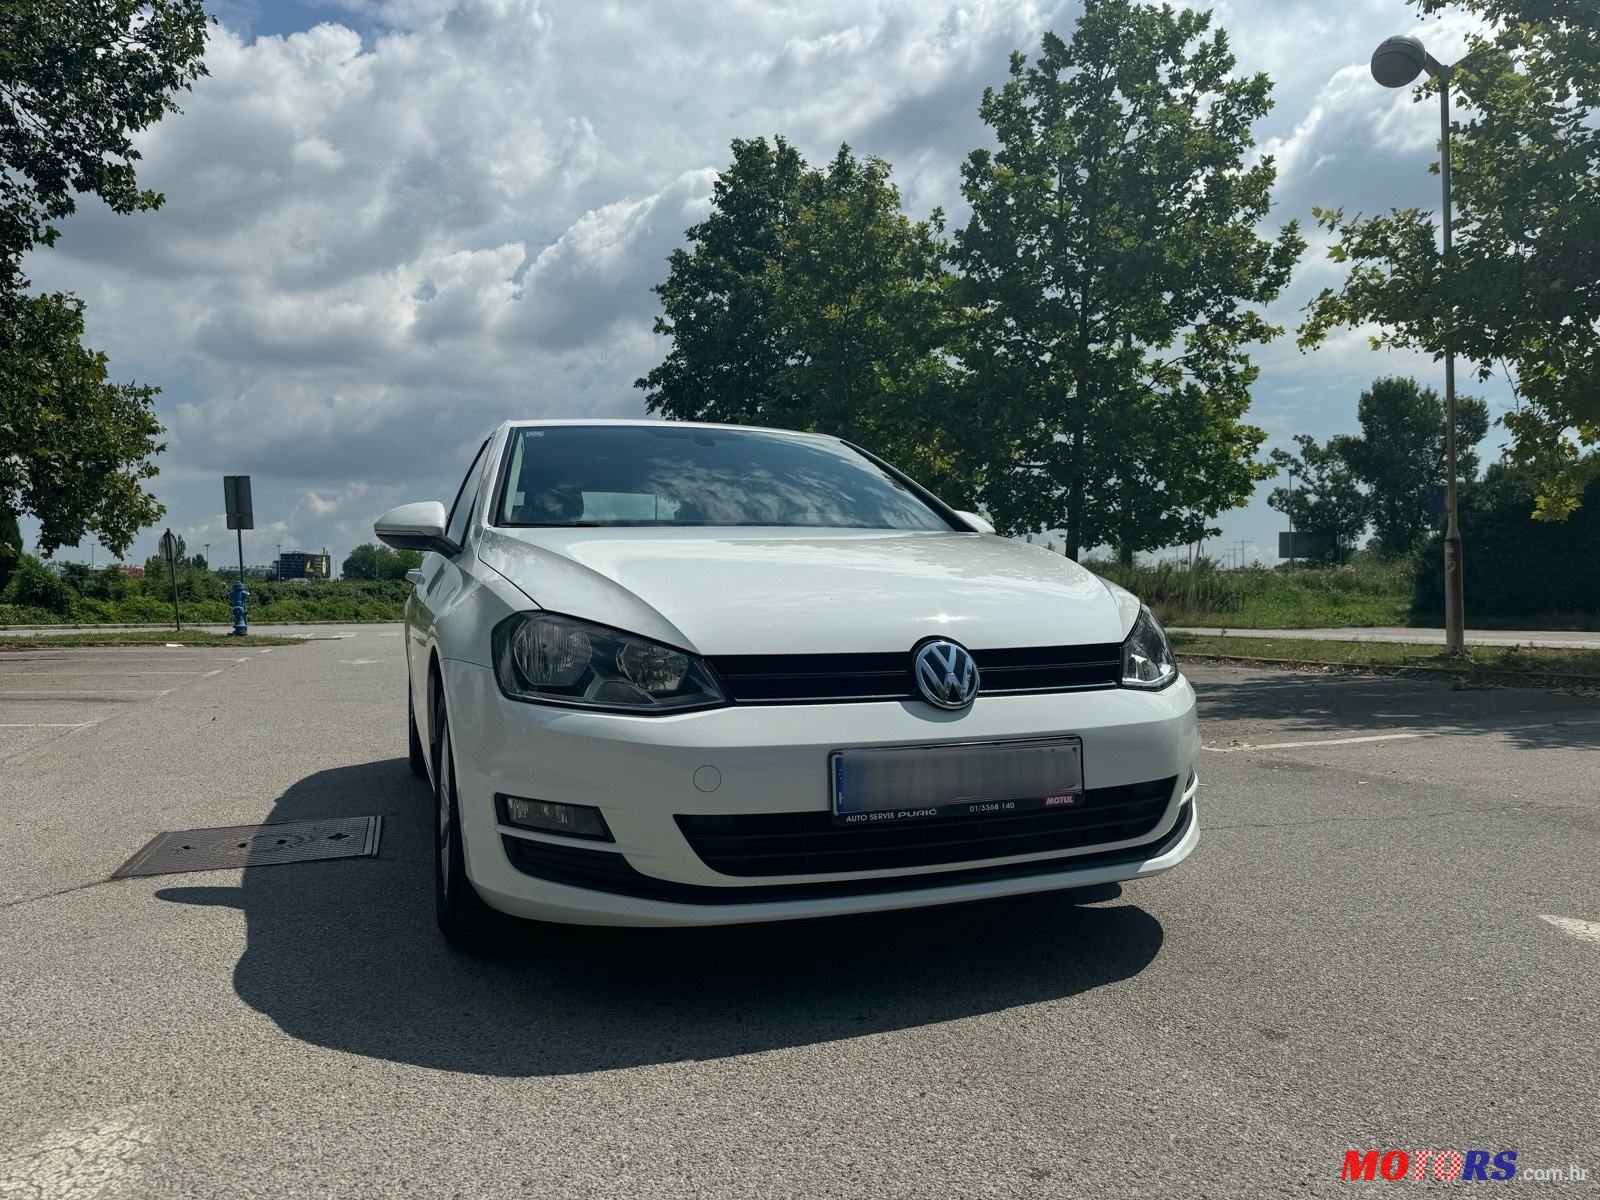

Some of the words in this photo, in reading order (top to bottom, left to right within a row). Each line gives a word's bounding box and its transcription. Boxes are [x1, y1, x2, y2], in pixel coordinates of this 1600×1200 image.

[1046, 795, 1074, 805] MOTUL
[1002, 802, 1015, 810] 140
[846, 814, 868, 823] AUTO
[869, 812, 895, 821] SERVIS
